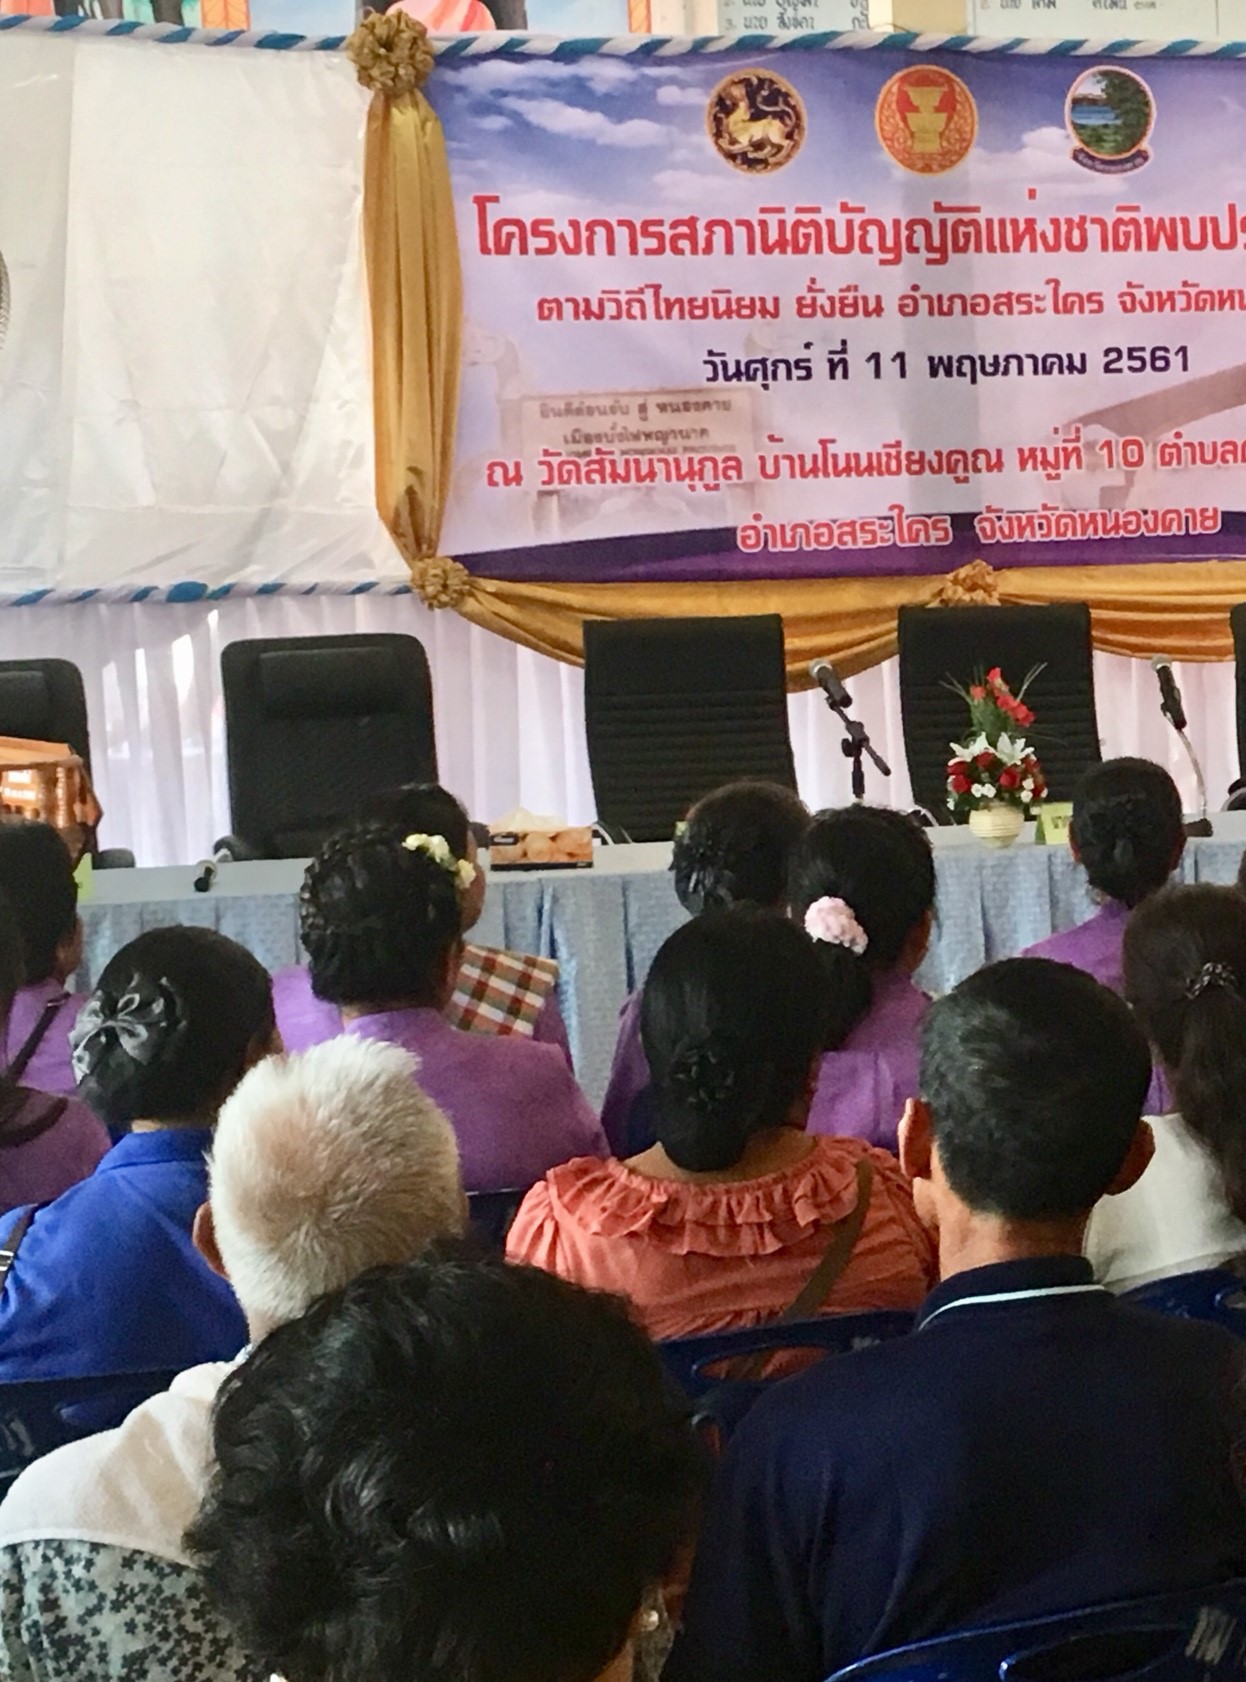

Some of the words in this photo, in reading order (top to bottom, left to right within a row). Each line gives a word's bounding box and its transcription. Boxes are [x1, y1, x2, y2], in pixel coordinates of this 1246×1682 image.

[537, 284, 780, 321] ตามวิถีไทยนิยม
[796, 278, 884, 319] ยั่งยืน
[898, 278, 1104, 318] อำเภอสระใคร
[702, 342, 814, 390] วันศุกร์
[827, 340, 849, 380] ที่
[866, 352, 907, 379] 11
[928, 353, 1087, 385] พฤษภาคม
[1103, 346, 1190, 374] 2561
[486, 460, 522, 487] ณ
[537, 447, 744, 492] วัดสัมนานุกูล
[758, 434, 1002, 484] บ้านโนนเชียงคูณ
[1017, 425, 1083, 480] หมู่ที่
[1099, 437, 1145, 469] 10
[738, 504, 951, 552] อำเภอสระใคร
[975, 503, 1222, 543] จังหวัดหนองคาย
